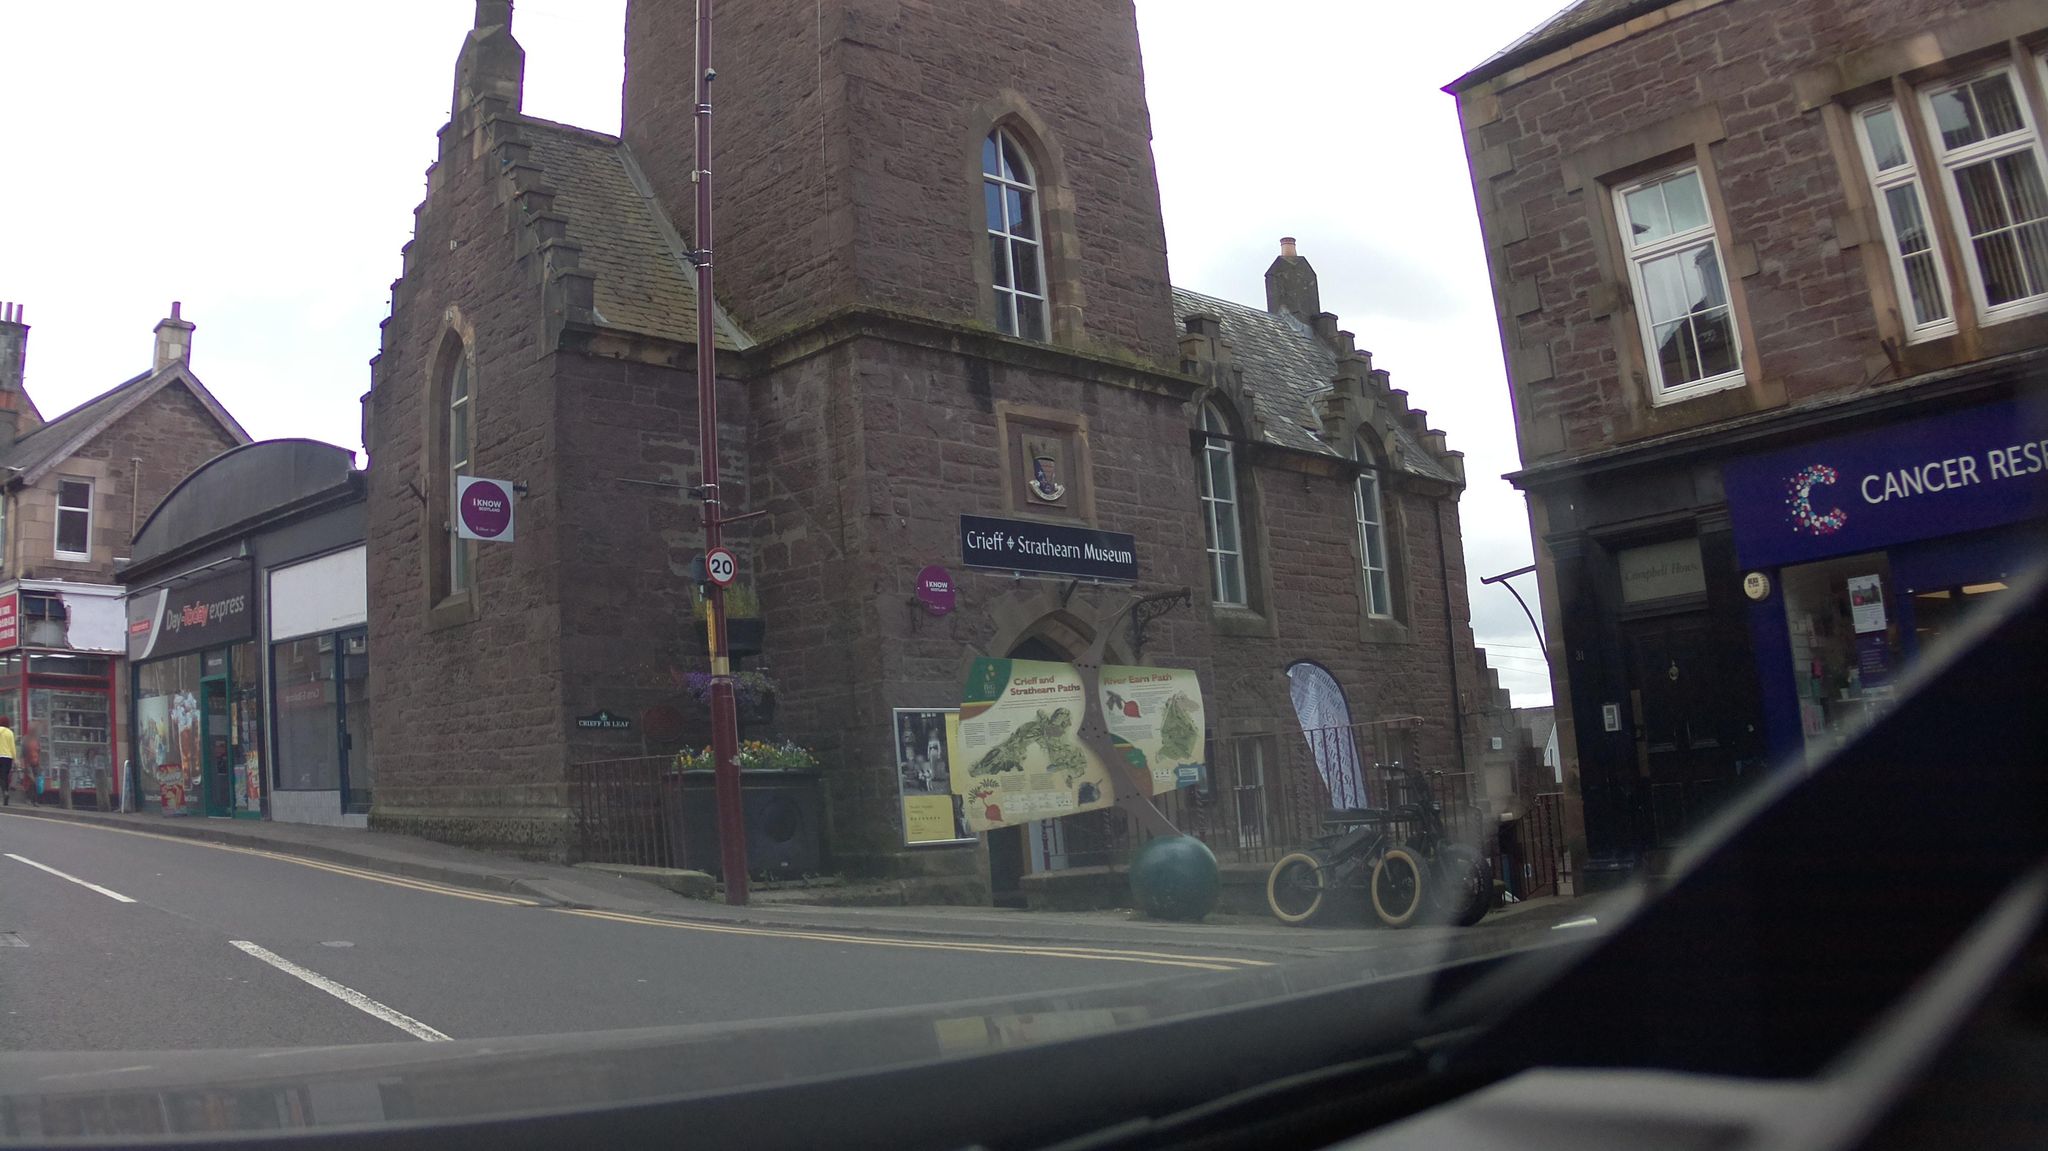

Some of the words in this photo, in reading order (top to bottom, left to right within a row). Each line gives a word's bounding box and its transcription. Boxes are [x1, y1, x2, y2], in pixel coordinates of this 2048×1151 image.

[1861, 455, 1980, 504] CANCER
[477, 499, 502, 508] KNOW
[966, 530, 1004, 552] Crieff
[1018, 535, 1081, 559] Strathearn
[1084, 543, 1132, 564] Museum
[711, 559, 732, 575] 20
[209, 595, 245, 623] express
[1013, 677, 1038, 686] Crieff
[1038, 675, 1055, 684] and
[1129, 675, 1151, 684] Earn
[1151, 673, 1173, 682] Path
[1010, 686, 1056, 697] Strathearn
[1057, 683, 1081, 693] Paths
